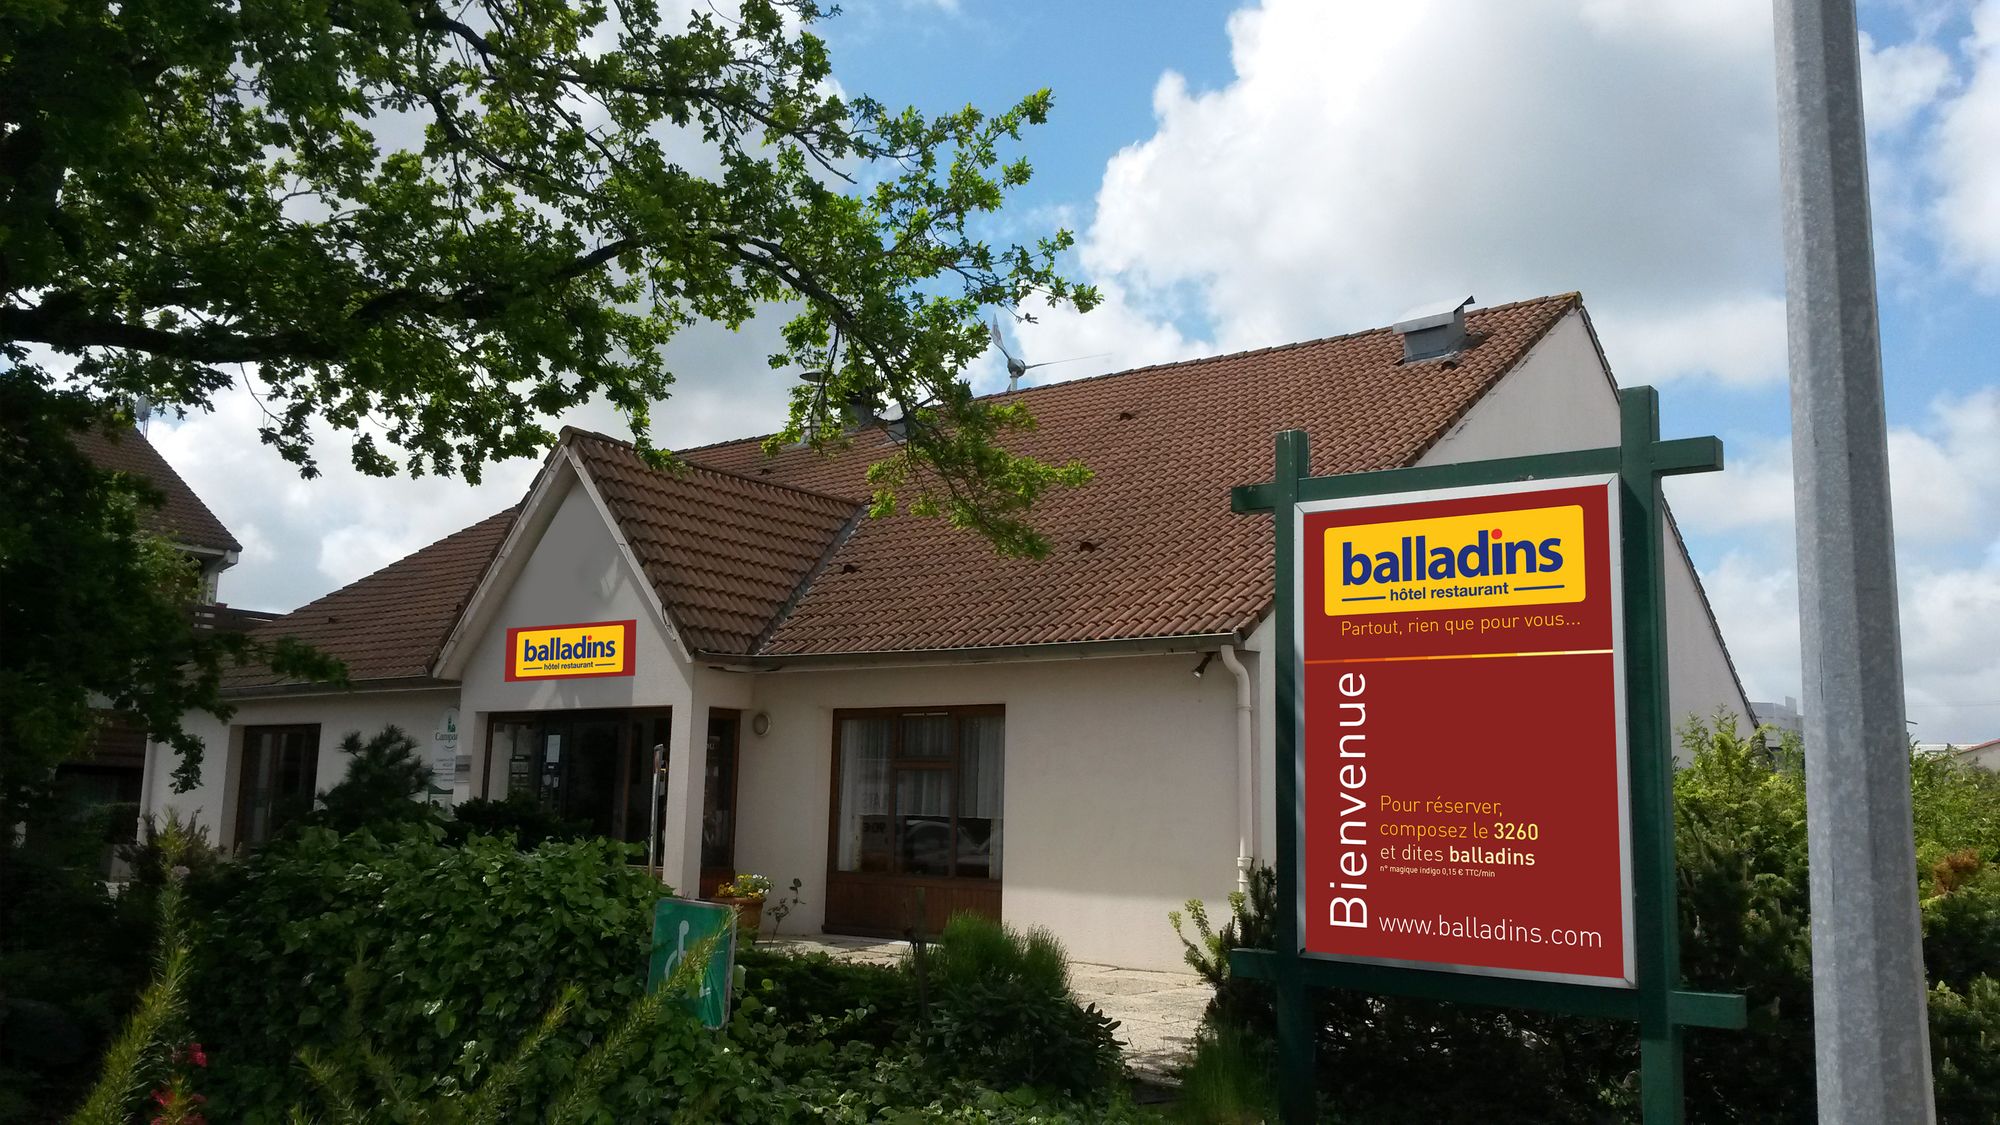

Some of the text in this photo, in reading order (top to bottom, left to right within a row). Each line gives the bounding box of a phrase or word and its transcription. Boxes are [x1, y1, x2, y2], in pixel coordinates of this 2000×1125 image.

[1342, 528, 1564, 587] balladins
[1391, 583, 1508, 600] hôtel restaurant
[1342, 615, 1580, 635] Partout, rien que pour vous...
[524, 636, 615, 661] balladins
[1330, 673, 1367, 928] Bienvenue
[1381, 795, 1502, 817] Pour réserver,
[1381, 822, 1538, 841] composez le 3260
[1381, 844, 1535, 865] et dites balladins
[1390, 866, 1418, 874] magique
[1420, 867, 1440, 876] indigo
[1442, 868, 1456, 876] 0,15
[1458, 868, 1464, 876] €
[1465, 869, 1495, 877] TTC/min
[1379, 914, 1602, 948] www.balladins.com
